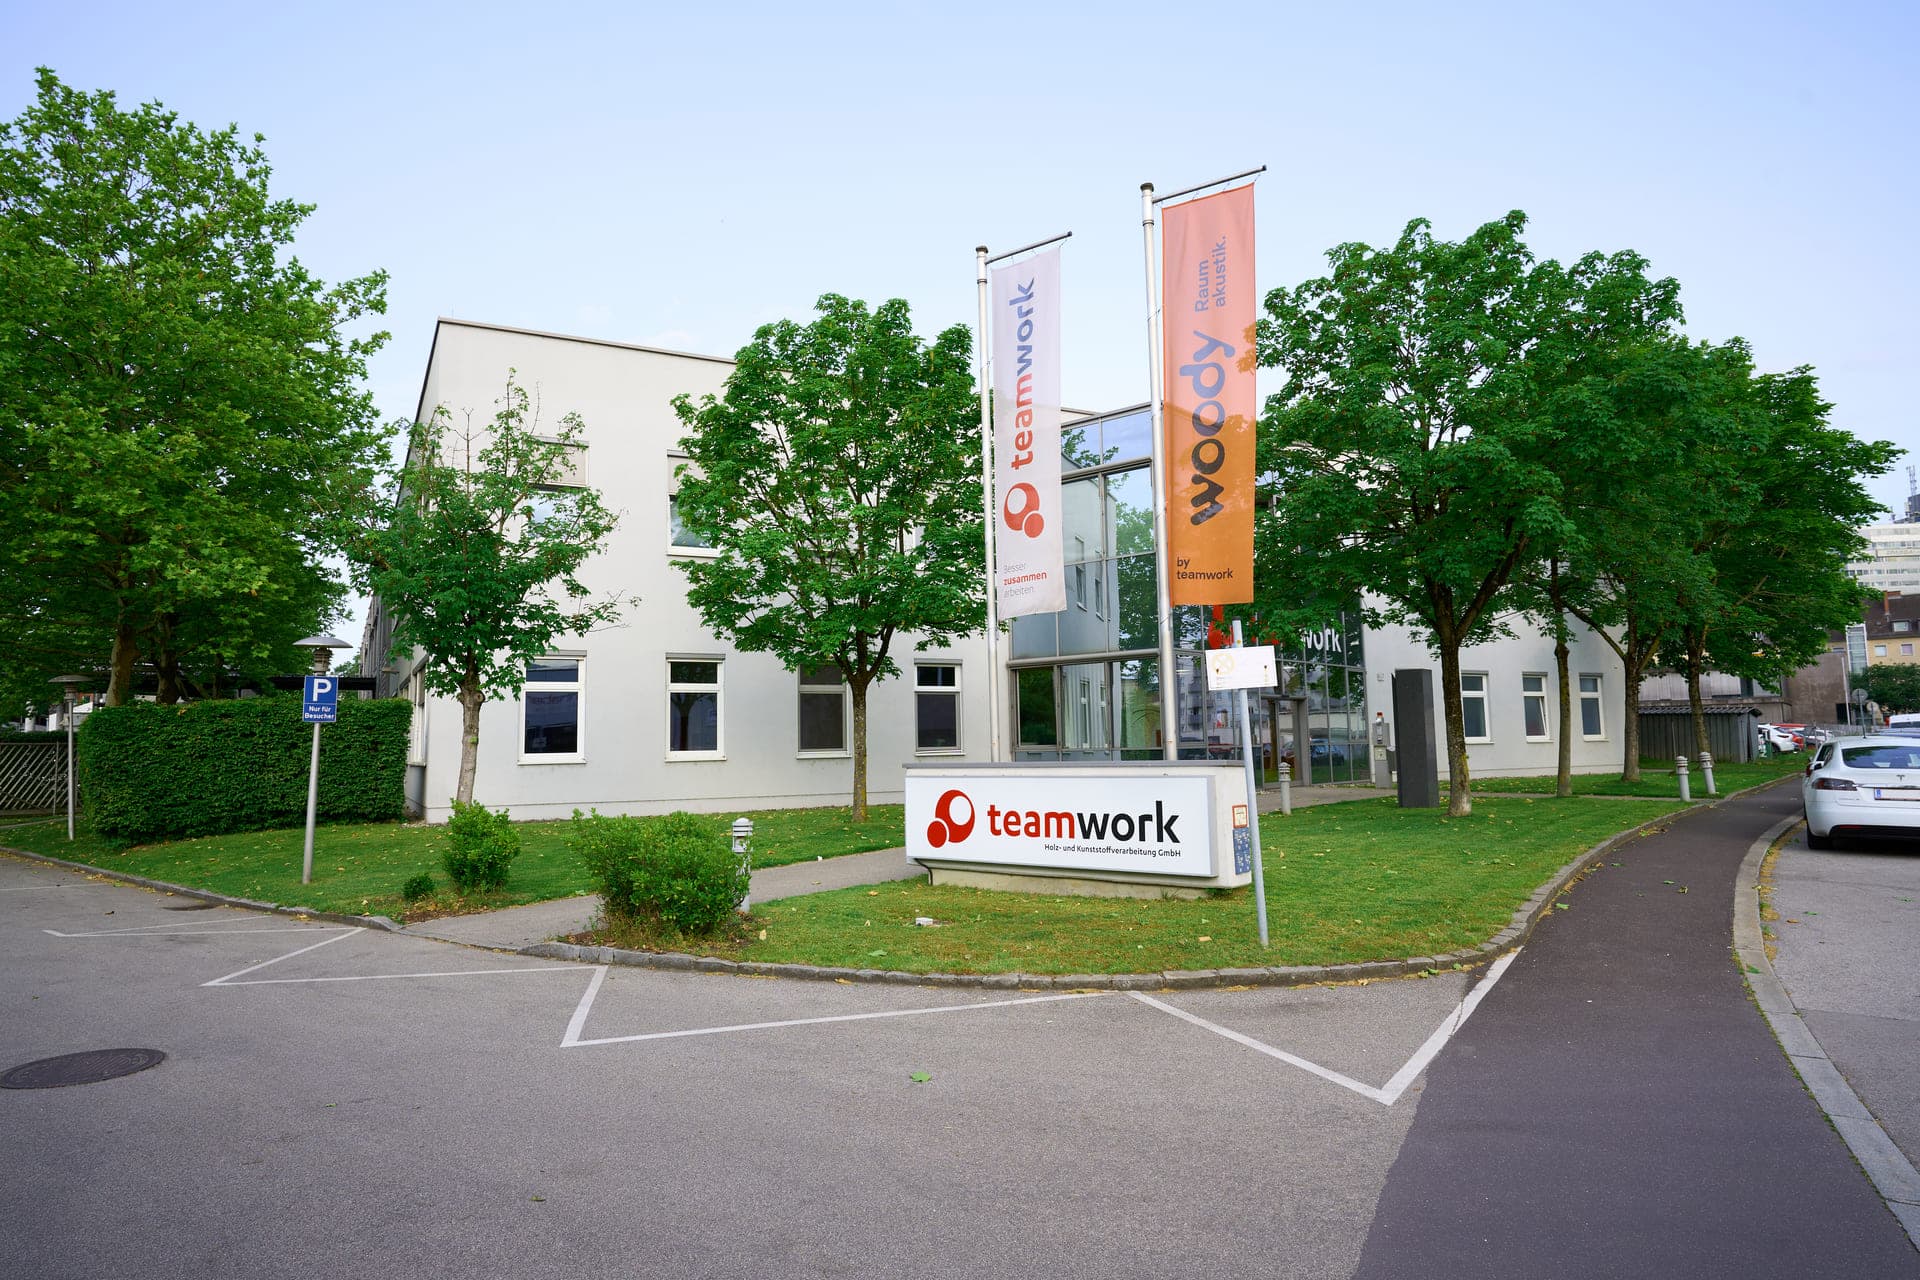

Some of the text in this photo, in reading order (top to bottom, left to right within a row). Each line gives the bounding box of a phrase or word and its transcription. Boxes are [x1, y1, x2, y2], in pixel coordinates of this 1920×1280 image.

[1195, 259, 1209, 312] Raum
[1212, 236, 1226, 307] akustik.
[1009, 277, 1035, 470] teamwork
[1179, 330, 1236, 526] woody
[1003, 572, 1047, 585] zusammen
[1176, 568, 1233, 580] teamwork
[1177, 556, 1190, 570] by
[313, 679, 332, 701] P
[987, 800, 1181, 844] teamwork
[1044, 844, 1061, 852] Holz-
[1077, 845, 1156, 857] Kunststoffverarbeitung
[1158, 849, 1181, 857] GmbH
